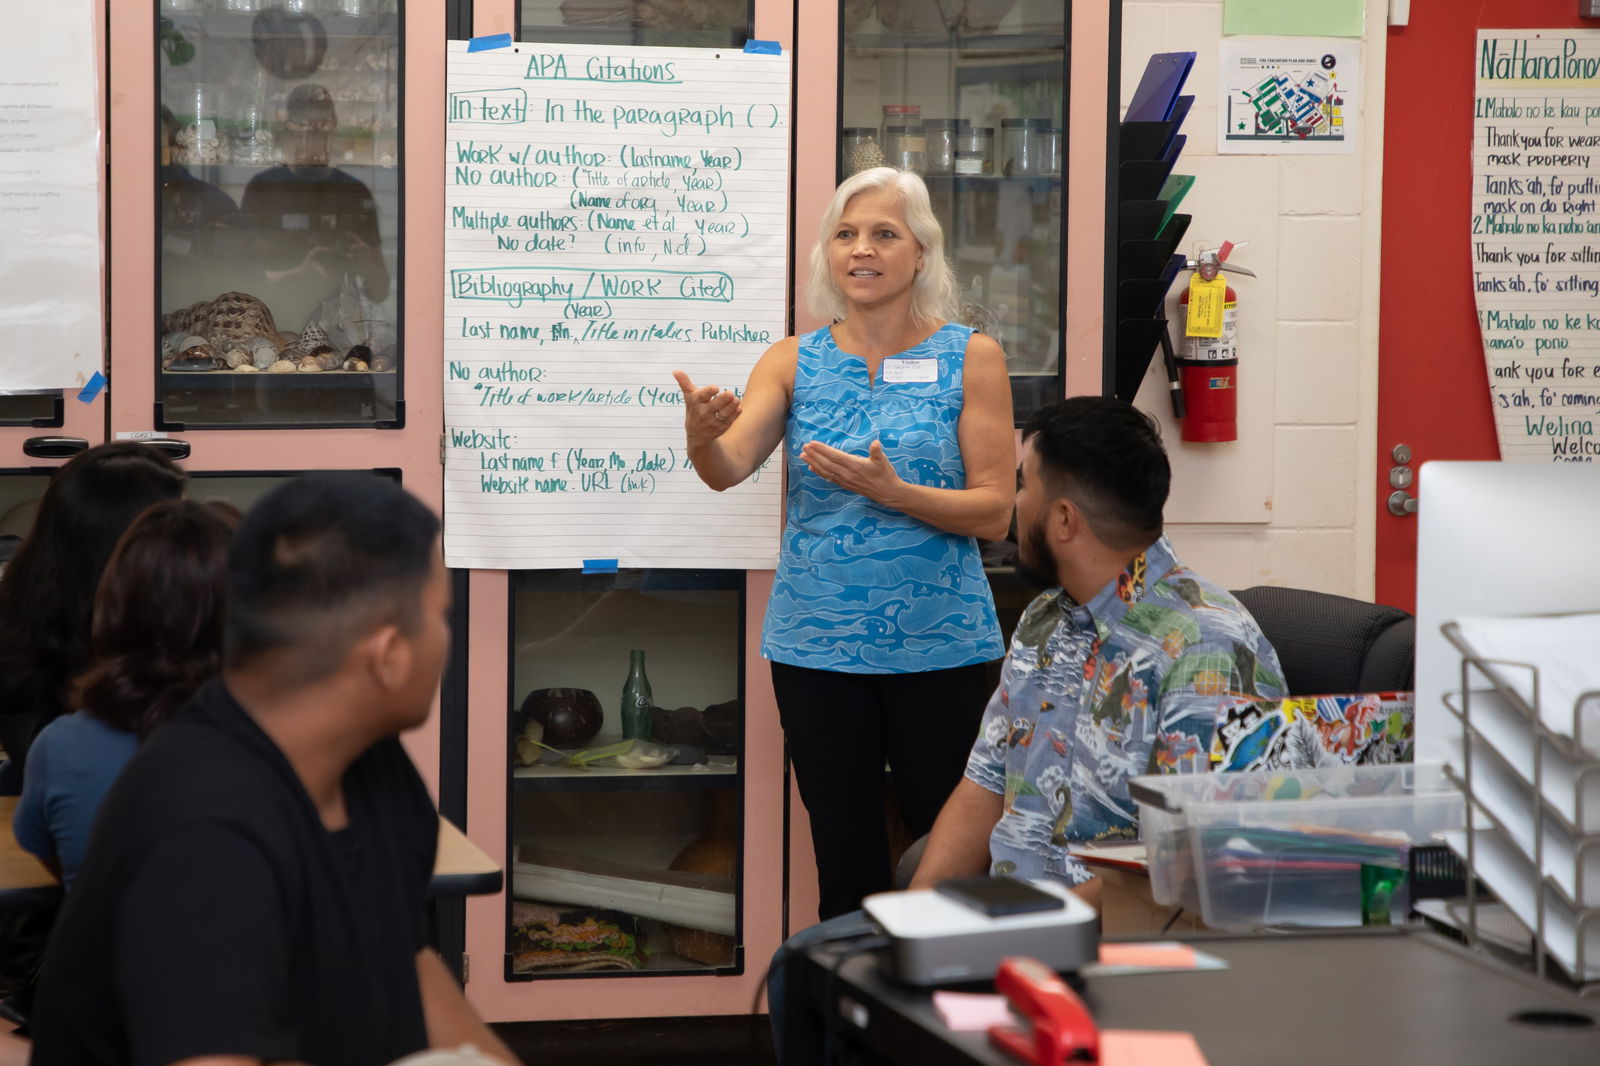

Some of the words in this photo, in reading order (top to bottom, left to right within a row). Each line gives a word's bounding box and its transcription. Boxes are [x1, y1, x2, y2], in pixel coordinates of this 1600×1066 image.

[526, 54, 567, 79] APA
[586, 57, 676, 80] Citations
[546, 98, 564, 123] In
[573, 99, 605, 123] the
[613, 104, 734, 137] paragraph
[1485, 97, 1522, 118] Mahalo
[1526, 106, 1540, 118] no
[1544, 97, 1555, 118] ke
[1521, 136, 1542, 151] you
[508, 144, 531, 165] w/
[1487, 152, 1521, 166] mask
[455, 166, 482, 185] No
[1483, 198, 1517, 214] mask
[1520, 202, 1535, 214] on
[452, 206, 511, 234] Multiple
[1526, 223, 1540, 234] no
[497, 235, 519, 251] No
[525, 232, 575, 252] date?
[1475, 242, 1513, 263] Thank
[1516, 252, 1540, 267] you
[458, 272, 574, 308] Bibliography
[680, 276, 728, 300] Cited
[1487, 310, 1536, 330] Mahalo
[1543, 319, 1558, 330] no
[1565, 313, 1581, 330] ke
[582, 320, 619, 341] Title
[1535, 337, 1569, 356] pono
[449, 361, 470, 380] No
[1525, 367, 1554, 384] you
[1526, 415, 1593, 436] Welina
[481, 474, 529, 494] Website
